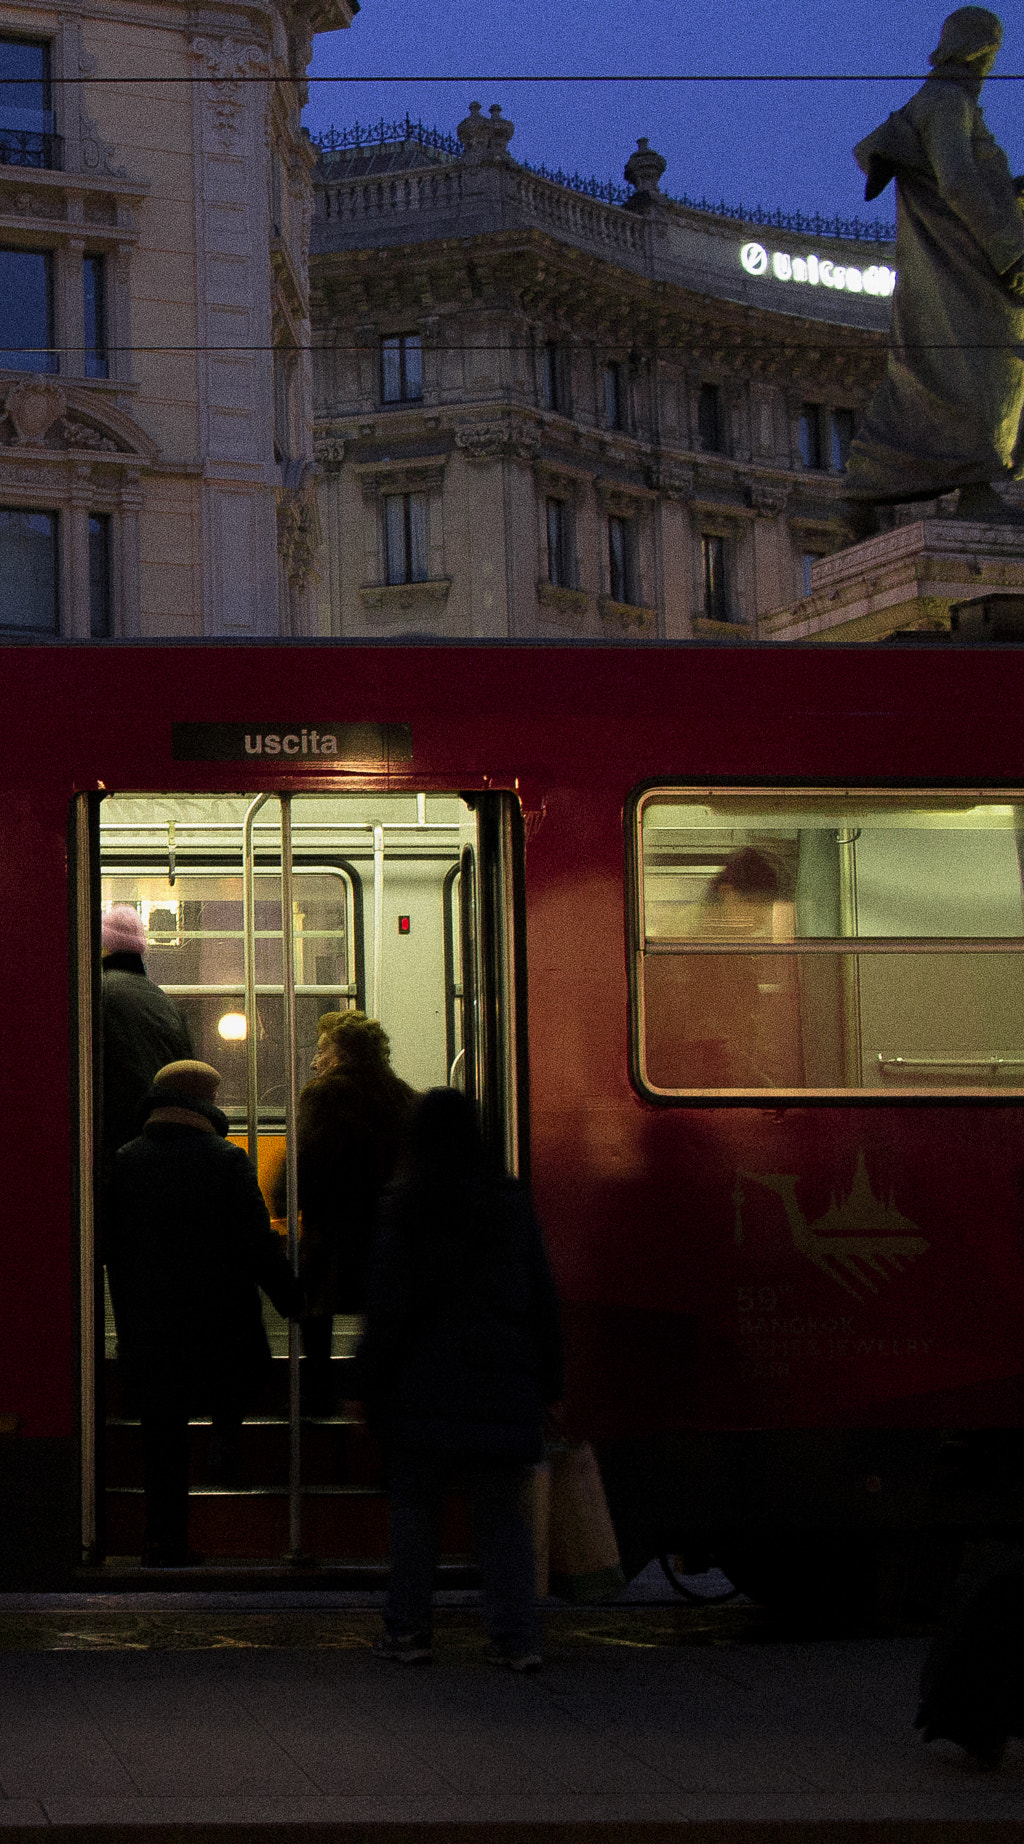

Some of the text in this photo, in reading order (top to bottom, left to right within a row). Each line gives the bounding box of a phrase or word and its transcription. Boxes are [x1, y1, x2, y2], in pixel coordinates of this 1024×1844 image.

[244, 729, 338, 754] uscita
[738, 1316, 856, 1335] BANGKOK
[827, 1337, 934, 1360] JEWELRY
